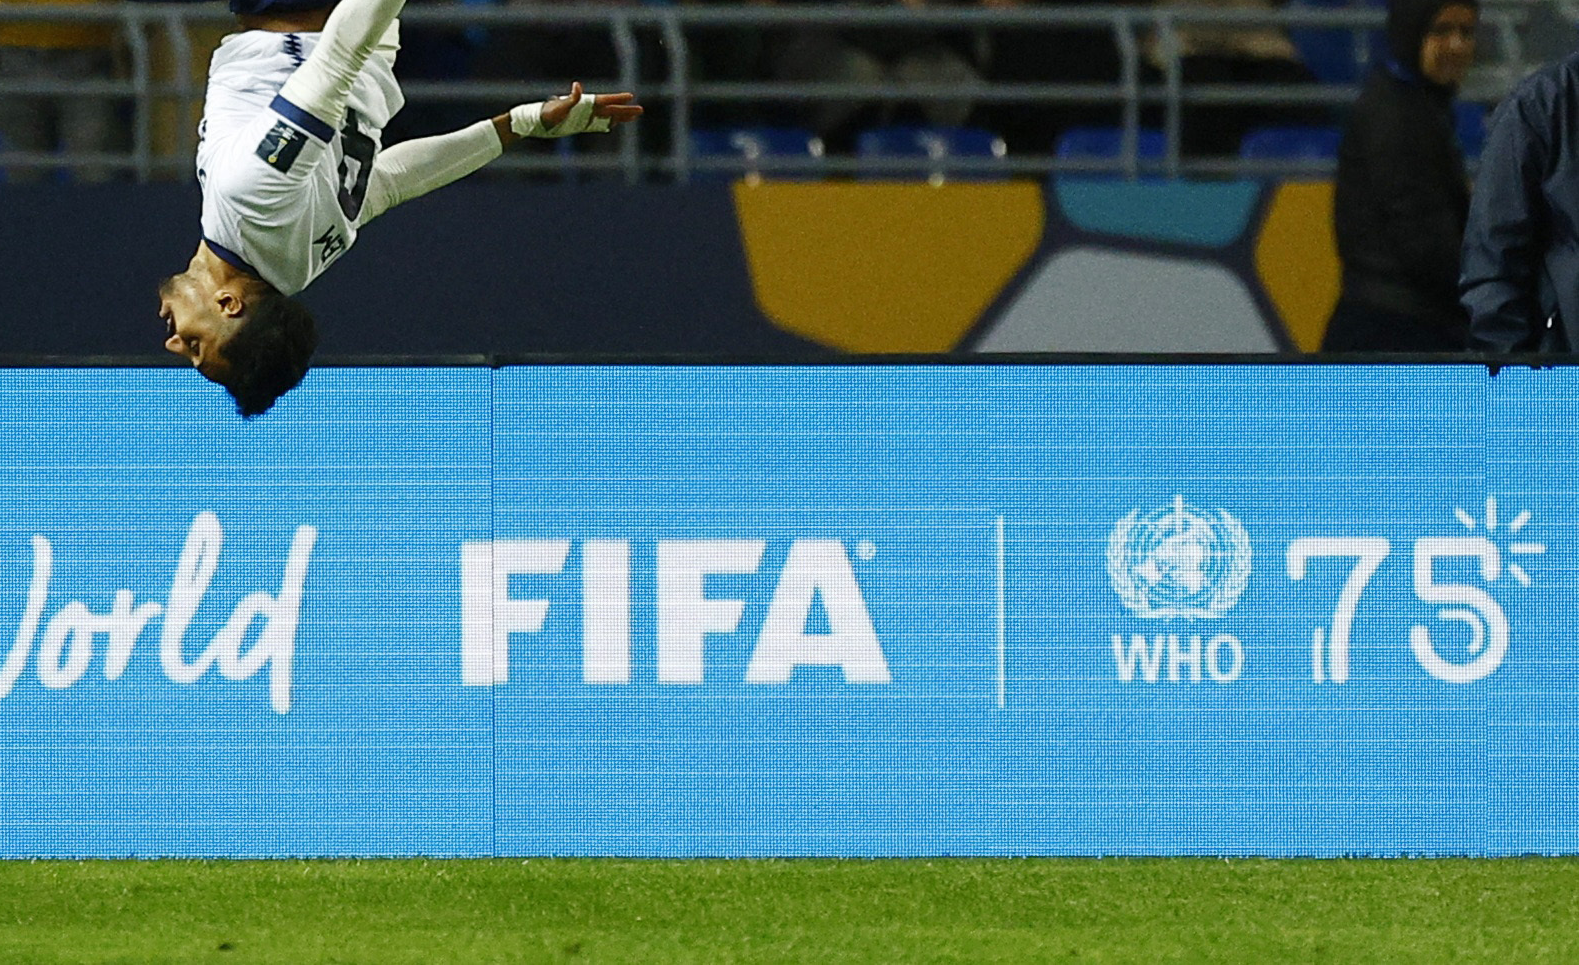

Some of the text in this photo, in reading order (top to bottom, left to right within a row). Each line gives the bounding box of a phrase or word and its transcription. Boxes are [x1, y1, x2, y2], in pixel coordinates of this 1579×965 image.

[460, 538, 892, 686] FIFA
[1112, 634, 1244, 683] WHO
[1286, 537, 1509, 684] 75
